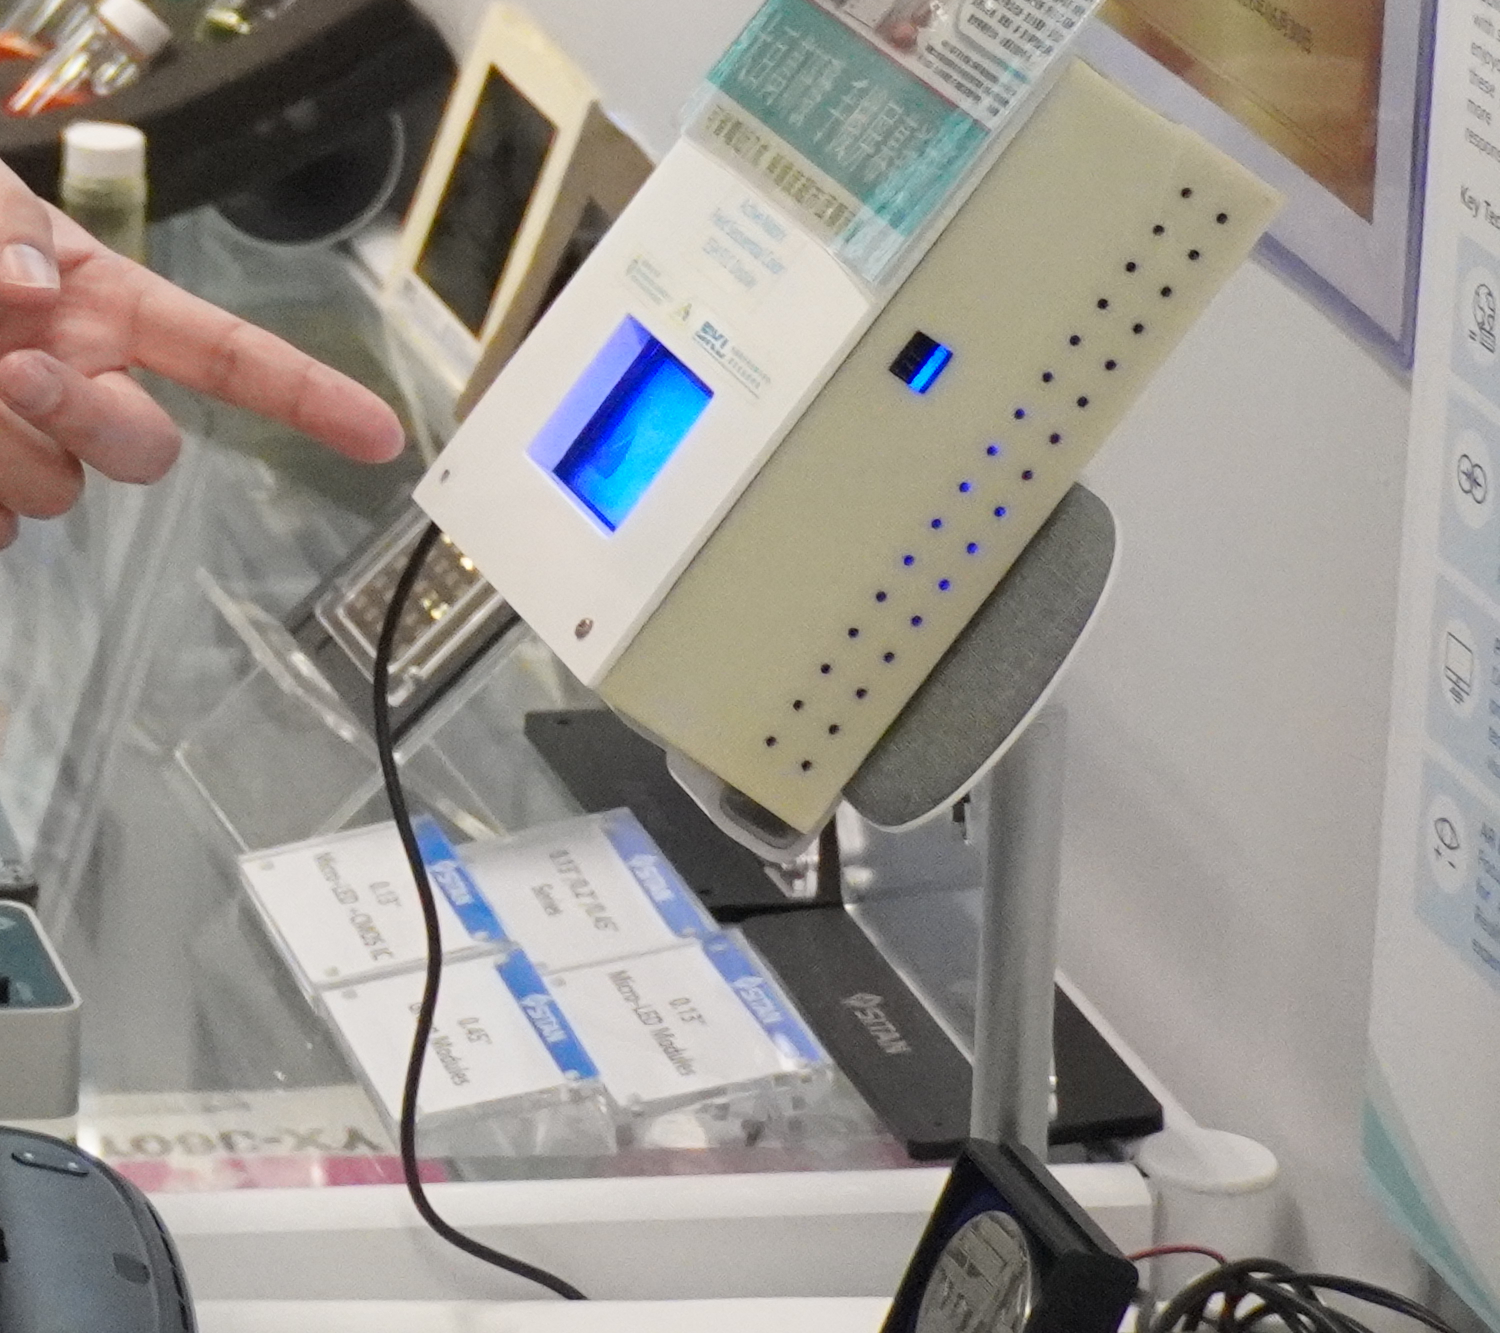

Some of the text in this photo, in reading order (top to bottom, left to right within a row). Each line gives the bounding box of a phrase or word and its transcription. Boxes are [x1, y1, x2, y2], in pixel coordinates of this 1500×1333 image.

[1460, 184, 1481, 219] Key
[313, 851, 359, 906] Micro-LED
[608, 969, 698, 1077] Micro-LED Modules
[853, 1005, 912, 1054] SITAN
[431, 1035, 471, 1087] Modules
